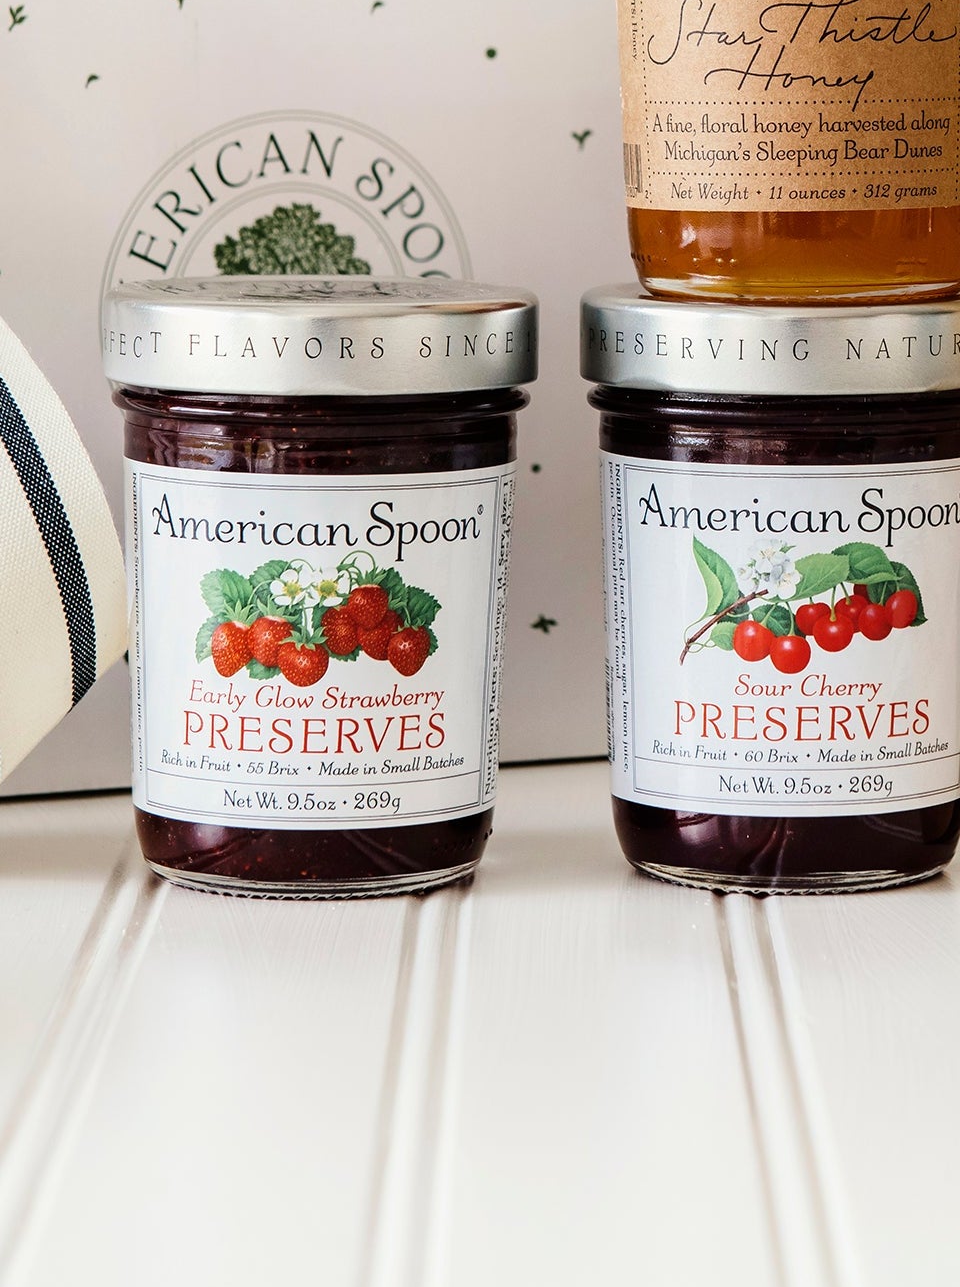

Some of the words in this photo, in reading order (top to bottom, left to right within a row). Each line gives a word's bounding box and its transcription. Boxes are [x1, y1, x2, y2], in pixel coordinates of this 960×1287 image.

[704, 44, 875, 111] Honey
[653, 115, 662, 132] A
[666, 113, 696, 136] fine,
[702, 113, 748, 133] floral
[753, 113, 812, 139] honey
[818, 112, 907, 132] harvested
[911, 113, 950, 135] along
[665, 141, 751, 167] Michigan's
[757, 141, 838, 167] Sleeping
[844, 140, 889, 159] Bear
[894, 139, 942, 159] Dunes
[119, 130, 343, 283] ERICAN
[355, 158, 451, 279] SPO
[671, 182, 693, 199] Net
[698, 183, 749, 205] Weight
[769, 186, 784, 199] 11
[788, 189, 846, 199] ounces
[864, 184, 890, 198] 312
[895, 187, 937, 203] grams
[189, 333, 384, 359] FLAVORS
[420, 332, 513, 358] SINCE
[589, 327, 809, 360] PRESERVING
[152, 494, 358, 546] American
[639, 484, 850, 533] American
[189, 680, 247, 712] Early
[256, 685, 313, 708] Glow
[322, 684, 444, 710] Strawberry
[735, 674, 791, 696] Sour
[801, 675, 882, 702] Cherry
[184, 710, 444, 754] PRESERVES
[674, 699, 929, 742] PRESERVES
[162, 749, 182, 766] Rich
[186, 757, 197, 768] in
[200, 756, 230, 771] Fruit
[247, 762, 264, 774] 55
[268, 761, 298, 775] Brix
[319, 761, 359, 775] Made
[363, 762, 378, 775] in
[381, 756, 420, 774] Small
[423, 753, 464, 770] Batches
[652, 740, 676, 757] Rich
[680, 747, 691, 758] in
[695, 745, 726, 760] Fruit
[745, 751, 763, 762] 60
[768, 749, 798, 762] Brix
[818, 749, 856, 762] Made
[861, 751, 873, 761] in
[877, 743, 912, 760] Small
[915, 740, 949, 757] Batches
[720, 775, 748, 793] Net
[752, 777, 778, 794] Wt.
[785, 778, 831, 794] 9.5oz
[849, 775, 894, 797] 269g
[224, 789, 252, 808] Net
[256, 792, 282, 809] Wt.
[288, 793, 336, 810] 9.5oz
[354, 791, 401, 814] 269g
